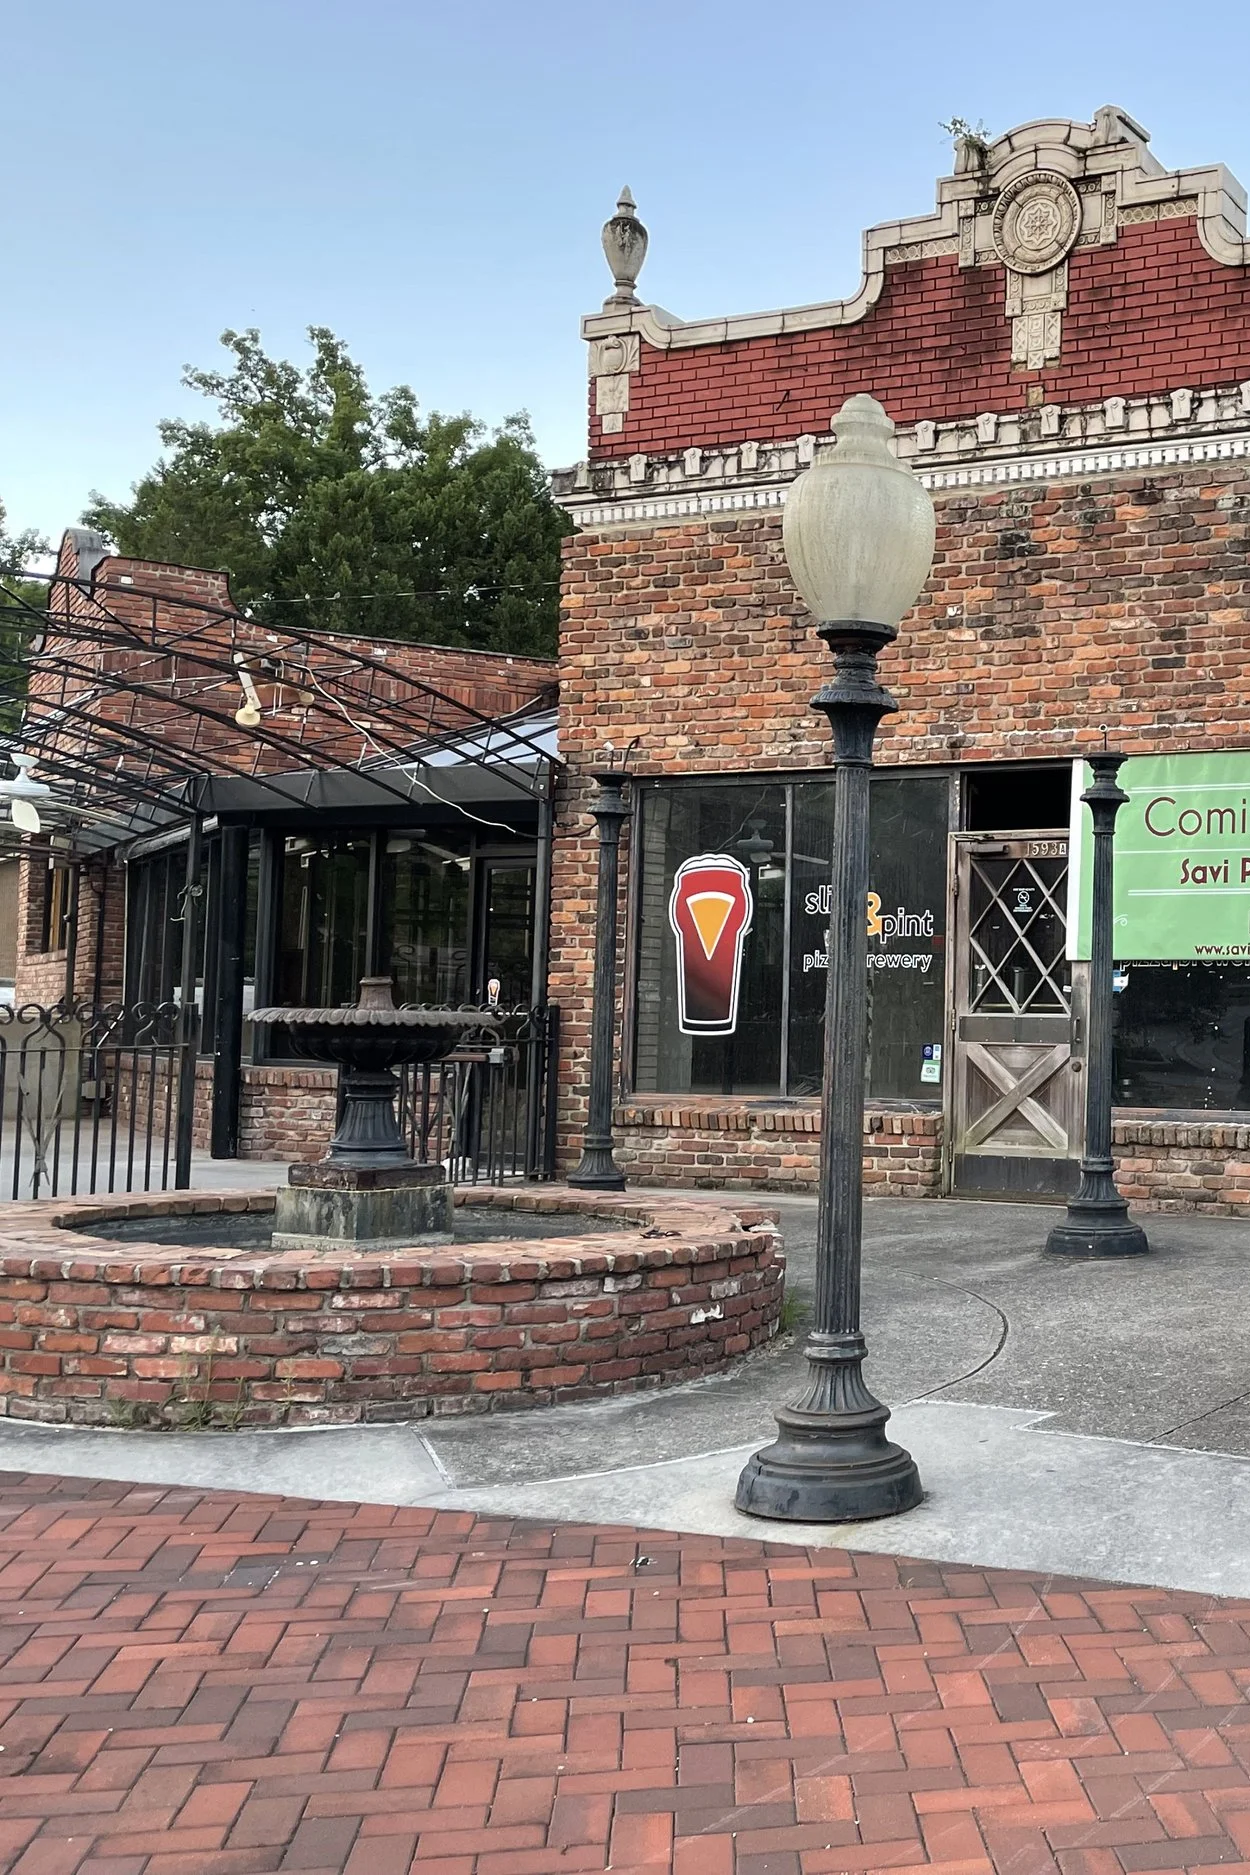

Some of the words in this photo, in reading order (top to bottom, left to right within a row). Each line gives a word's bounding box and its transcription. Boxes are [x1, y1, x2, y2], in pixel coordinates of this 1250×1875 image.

[1180, 858, 1229, 885] Savi
[804, 885, 832, 914] sli
[880, 907, 934, 944] pint
[803, 950, 829, 972] piz
[866, 954, 933, 973] rewery
